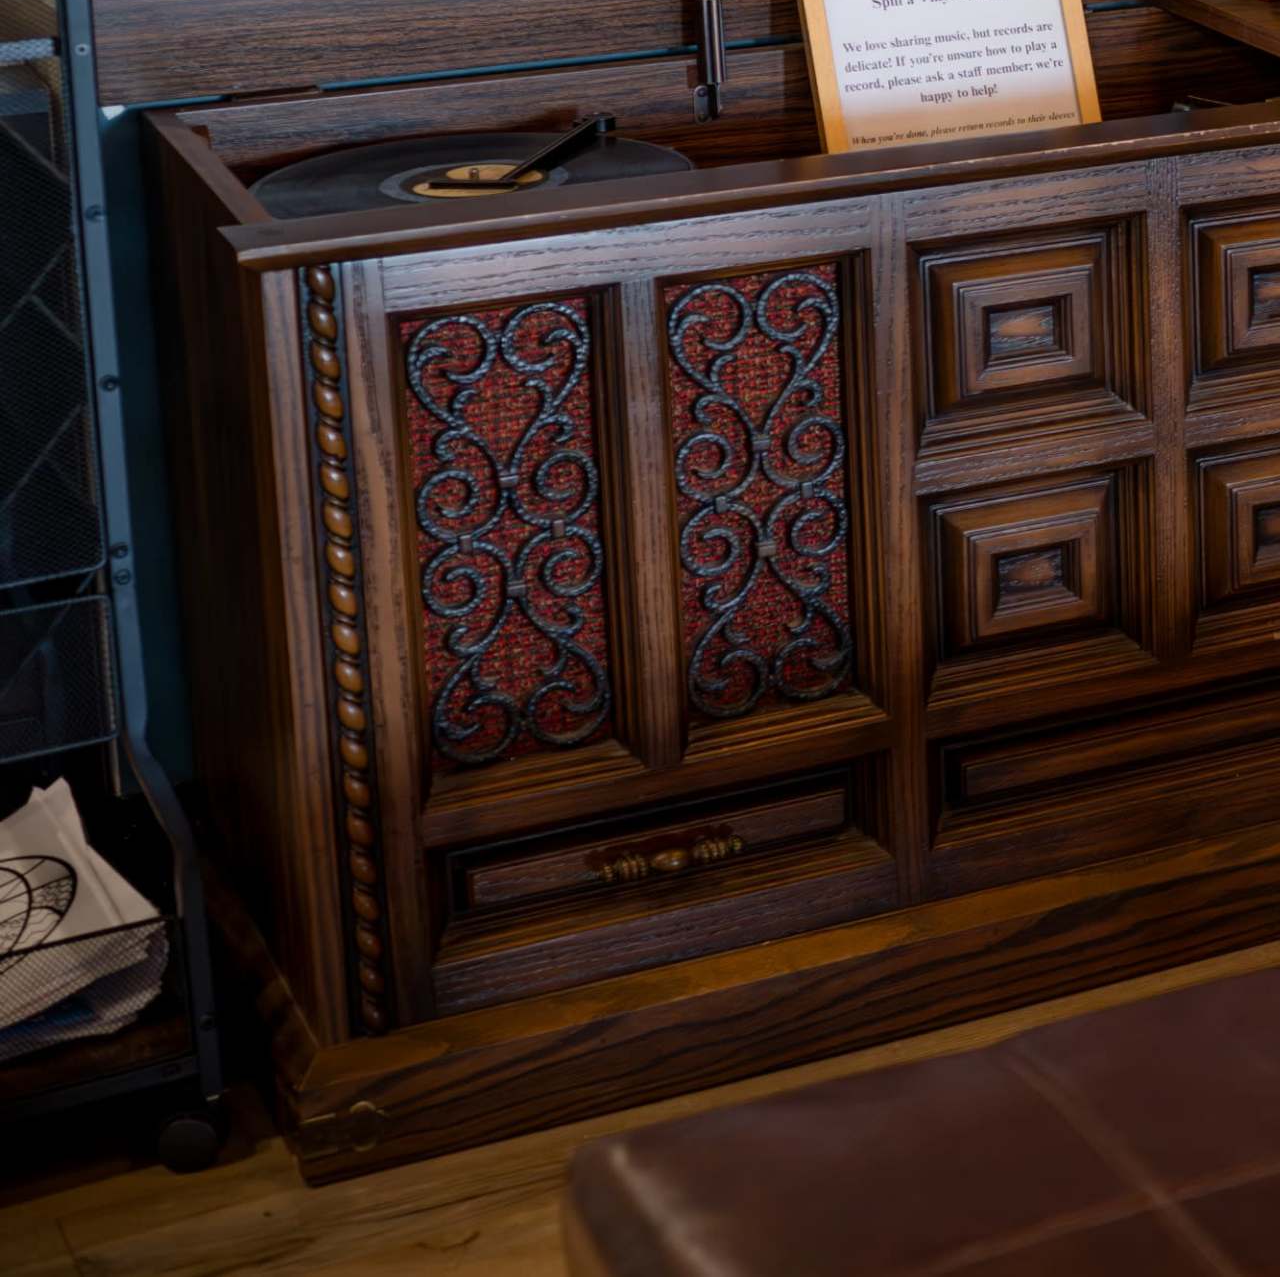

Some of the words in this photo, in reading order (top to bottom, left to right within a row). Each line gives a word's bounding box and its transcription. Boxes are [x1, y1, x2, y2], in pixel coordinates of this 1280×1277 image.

[843, 42, 862, 53] We
[865, 40, 887, 52] love
[890, 35, 931, 51] sharing
[973, 28, 991, 39] but
[993, 23, 1033, 37] records
[1037, 22, 1053, 32] are
[844, 58, 892, 73] delicate!
[896, 56, 906, 67] If
[910, 52, 944, 68] you're
[947, 49, 983, 62] unsure
[985, 46, 1007, 58] how
[1010, 44, 1022, 54] to
[1025, 41, 1047, 55] play
[1049, 41, 1057, 50] a
[844, 79, 885, 93] record,
[887, 74, 923, 89] please
[925, 70, 945, 82] ask
[948, 72, 955, 80] a
[957, 65, 983, 79] staff
[1036, 58, 1064, 69] we're
[920, 89, 954, 104] happy
[957, 88, 969, 98] to
[971, 82, 999, 98] help!
[852, 134, 877, 146] When
[878, 132, 903, 144] you're
[930, 125, 957, 138] please
[958, 122, 985, 133] return
[985, 117, 1016, 130] records
[1016, 116, 1026, 126] to
[1027, 112, 1047, 125] their
